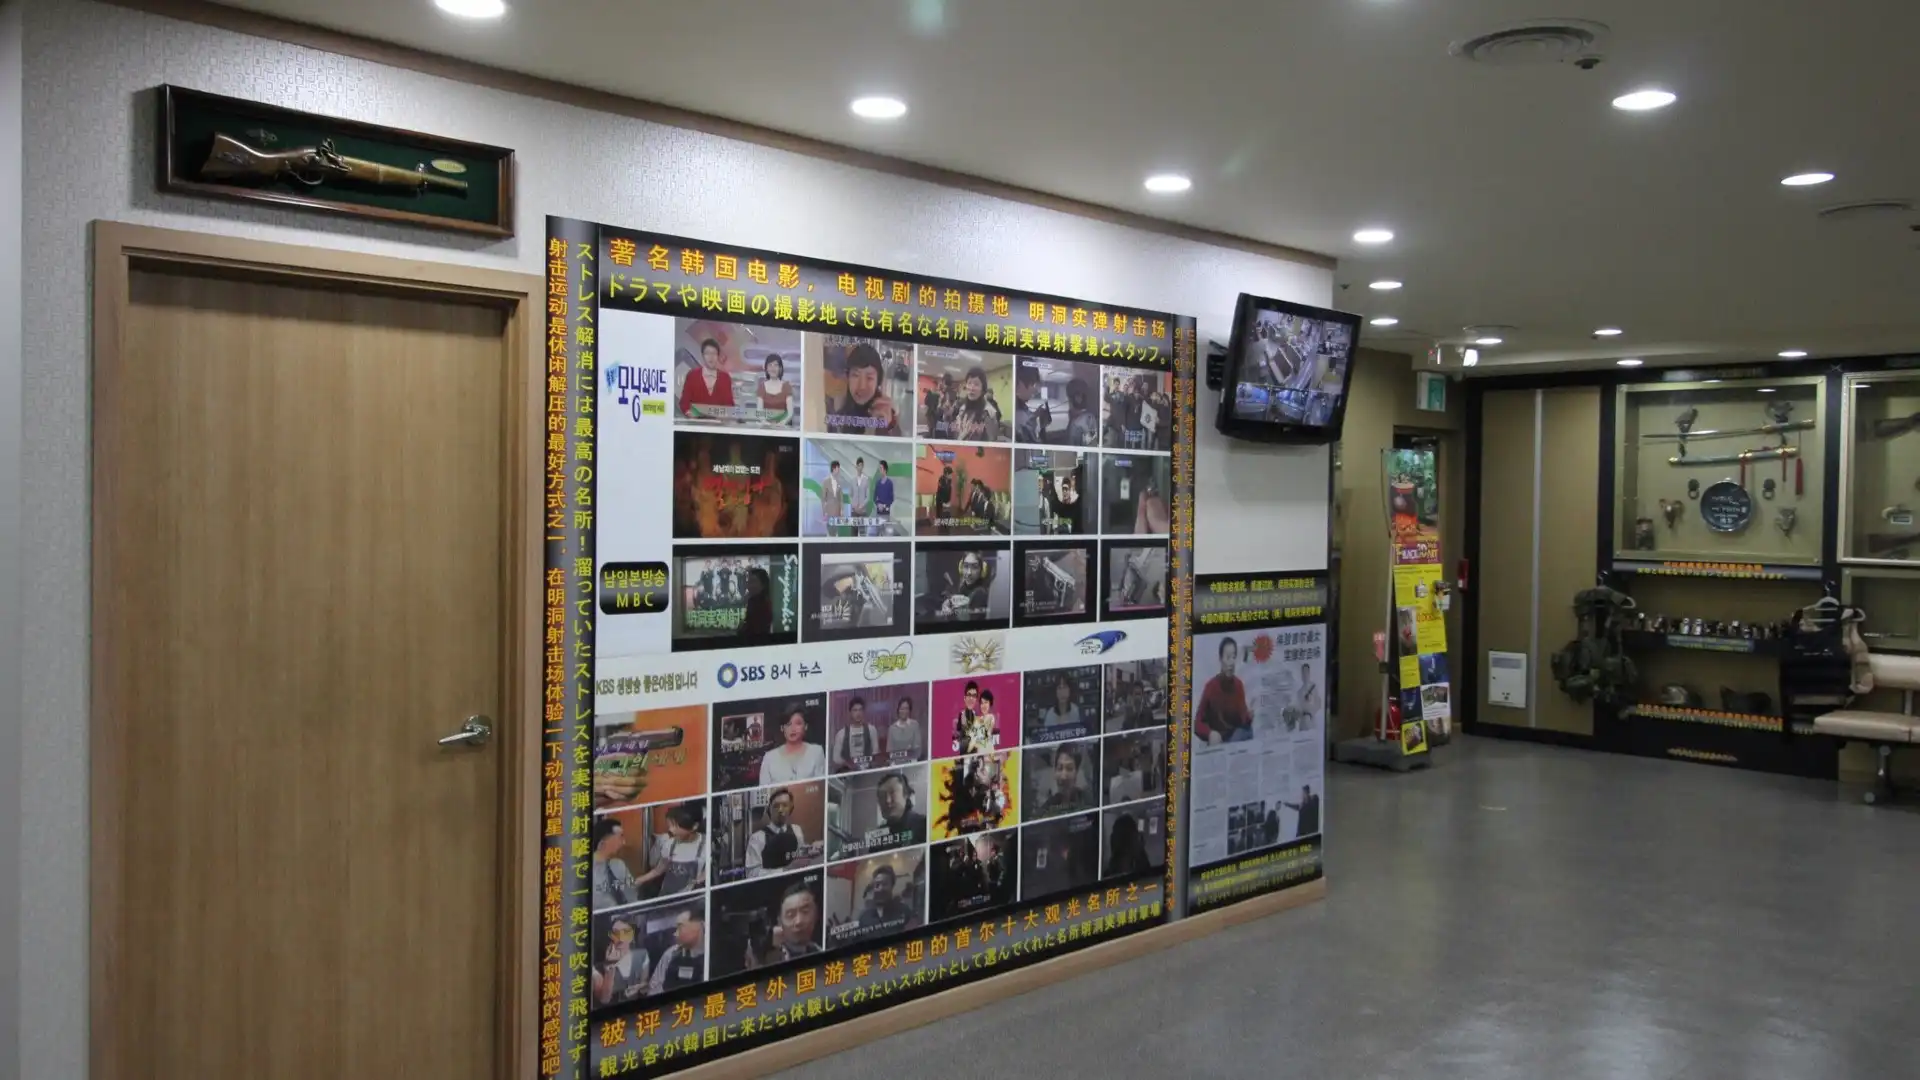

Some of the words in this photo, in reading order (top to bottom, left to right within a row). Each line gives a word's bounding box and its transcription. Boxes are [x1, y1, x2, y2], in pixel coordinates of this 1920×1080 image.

[1029, 302, 1166, 339] 明洞实弹射击场
[604, 568, 666, 589] 남일본방송
[848, 651, 864, 665] KBS
[741, 665, 766, 682] SBS
[771, 663, 793, 680] 8시
[798, 661, 822, 679] 뉴스
[596, 679, 615, 695] KBS
[617, 676, 641, 695] 생방송
[600, 882, 1158, 1047] 被评为最受外国游客欢迎的首尔十大观光名所之一
